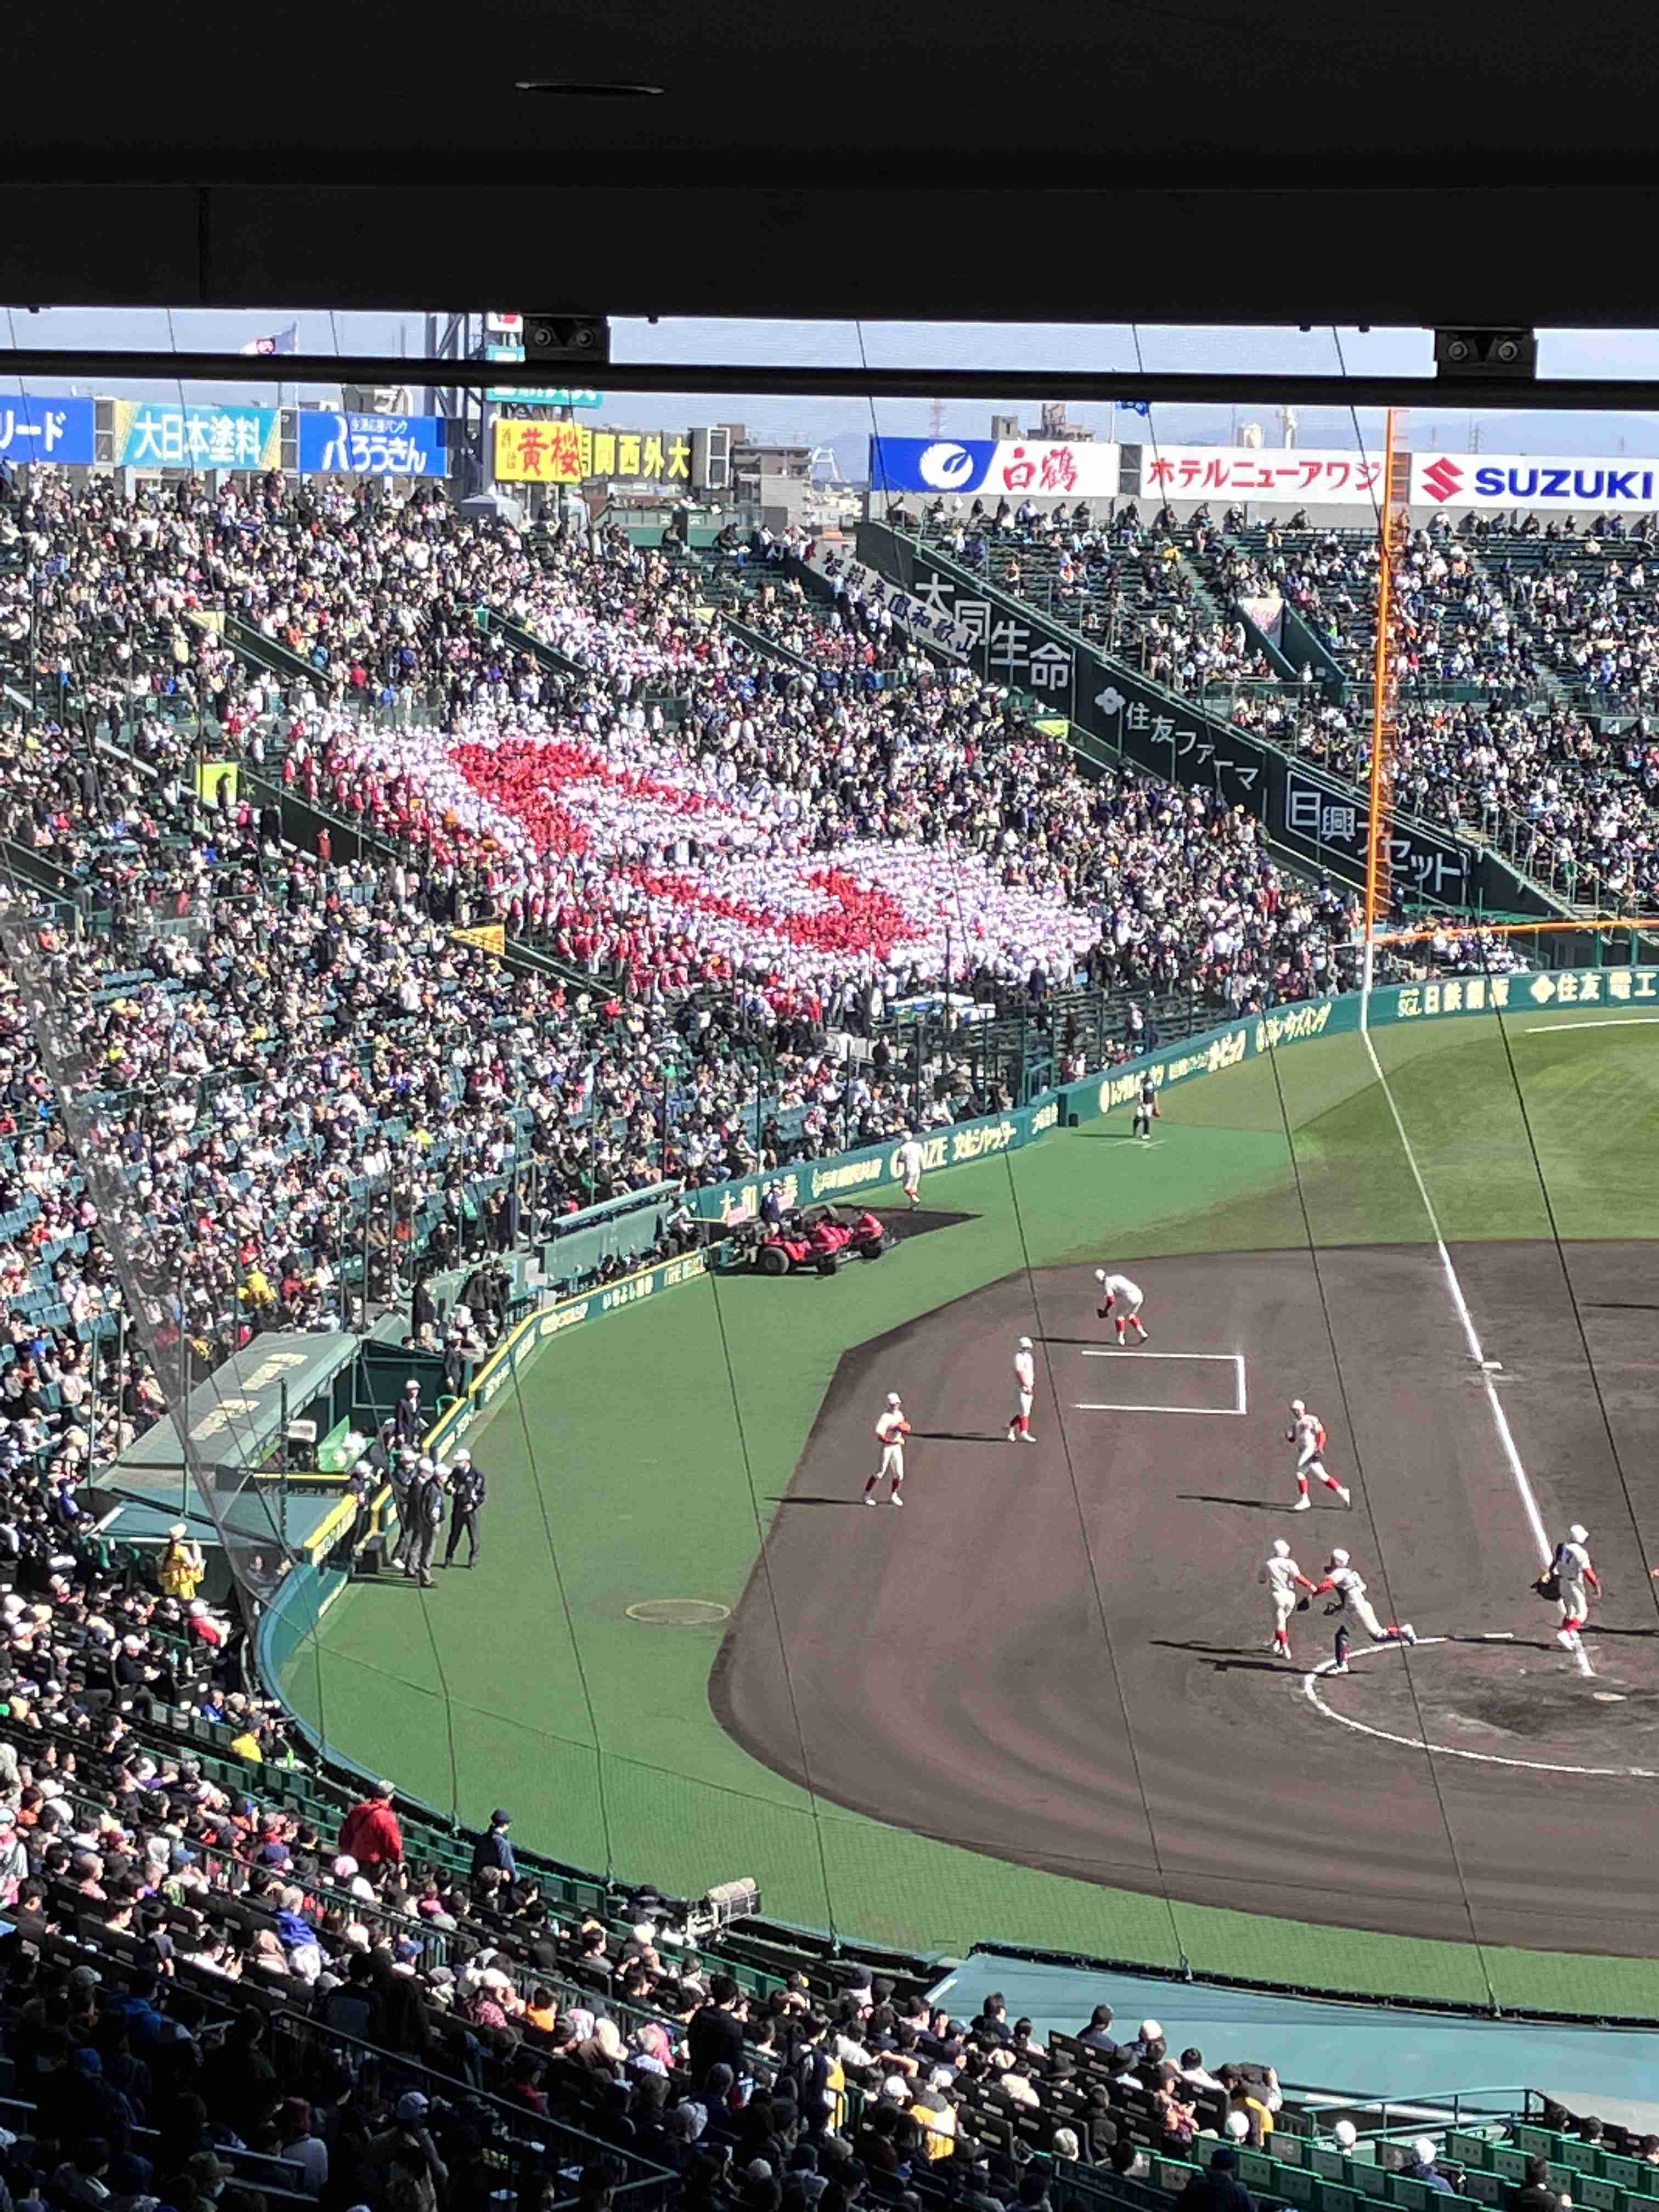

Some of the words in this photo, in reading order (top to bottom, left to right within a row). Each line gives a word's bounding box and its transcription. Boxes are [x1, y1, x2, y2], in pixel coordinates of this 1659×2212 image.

[133, 410, 261, 465] 大日本塗料
[351, 436, 427, 473] ろうきん
[1002, 447, 1079, 492] 白鶴
[1147, 458, 1381, 490] ホテルニューアワジ
[1475, 467, 1652, 500] SUZUKI
[915, 573, 1072, 690] 大同生命
[1126, 702, 1259, 790] 住友ファーマ
